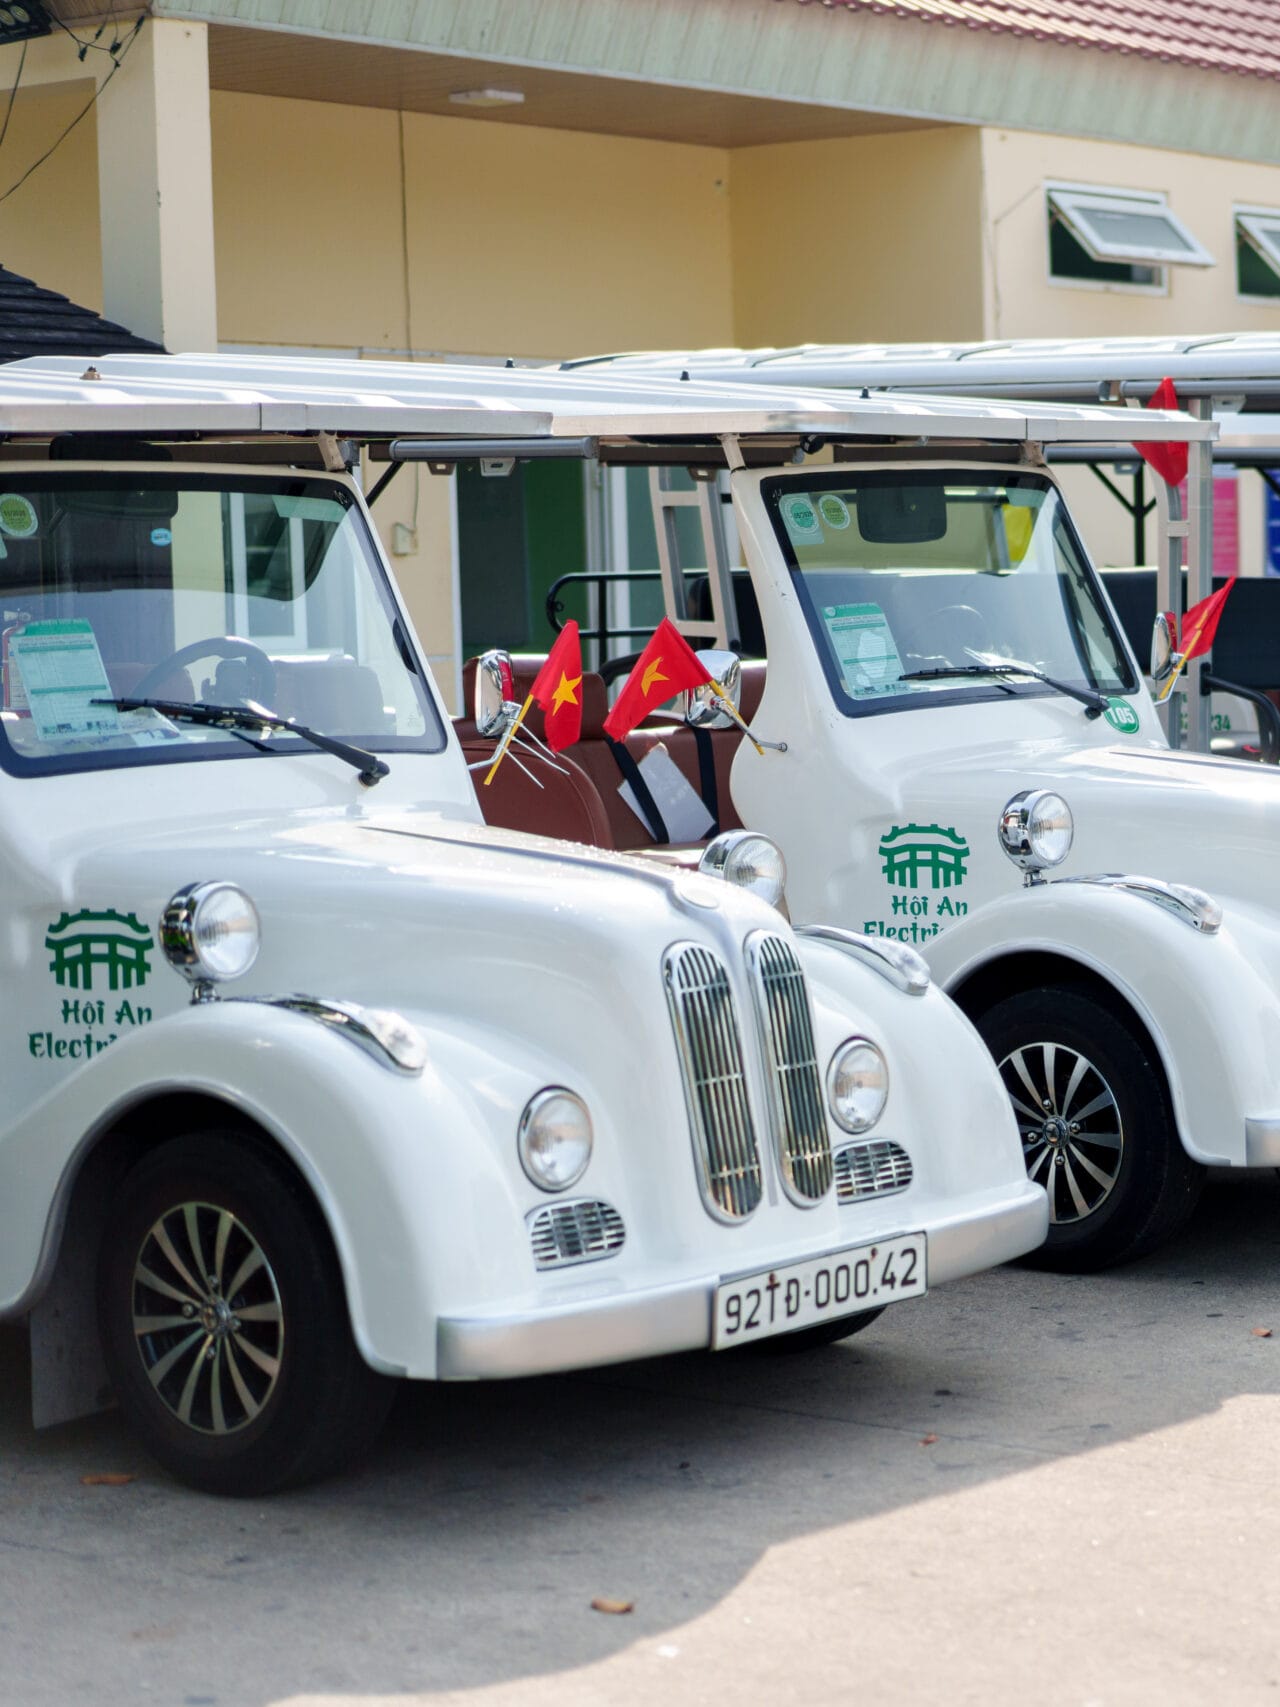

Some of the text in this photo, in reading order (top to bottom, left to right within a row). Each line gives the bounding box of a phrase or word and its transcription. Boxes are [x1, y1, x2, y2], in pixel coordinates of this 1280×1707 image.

[1108, 706, 1136, 724] 105
[1210, 713, 1231, 731] 34
[891, 895, 968, 920] Hội An
[863, 920, 945, 944] Electri
[61, 998, 153, 1030] Hội An
